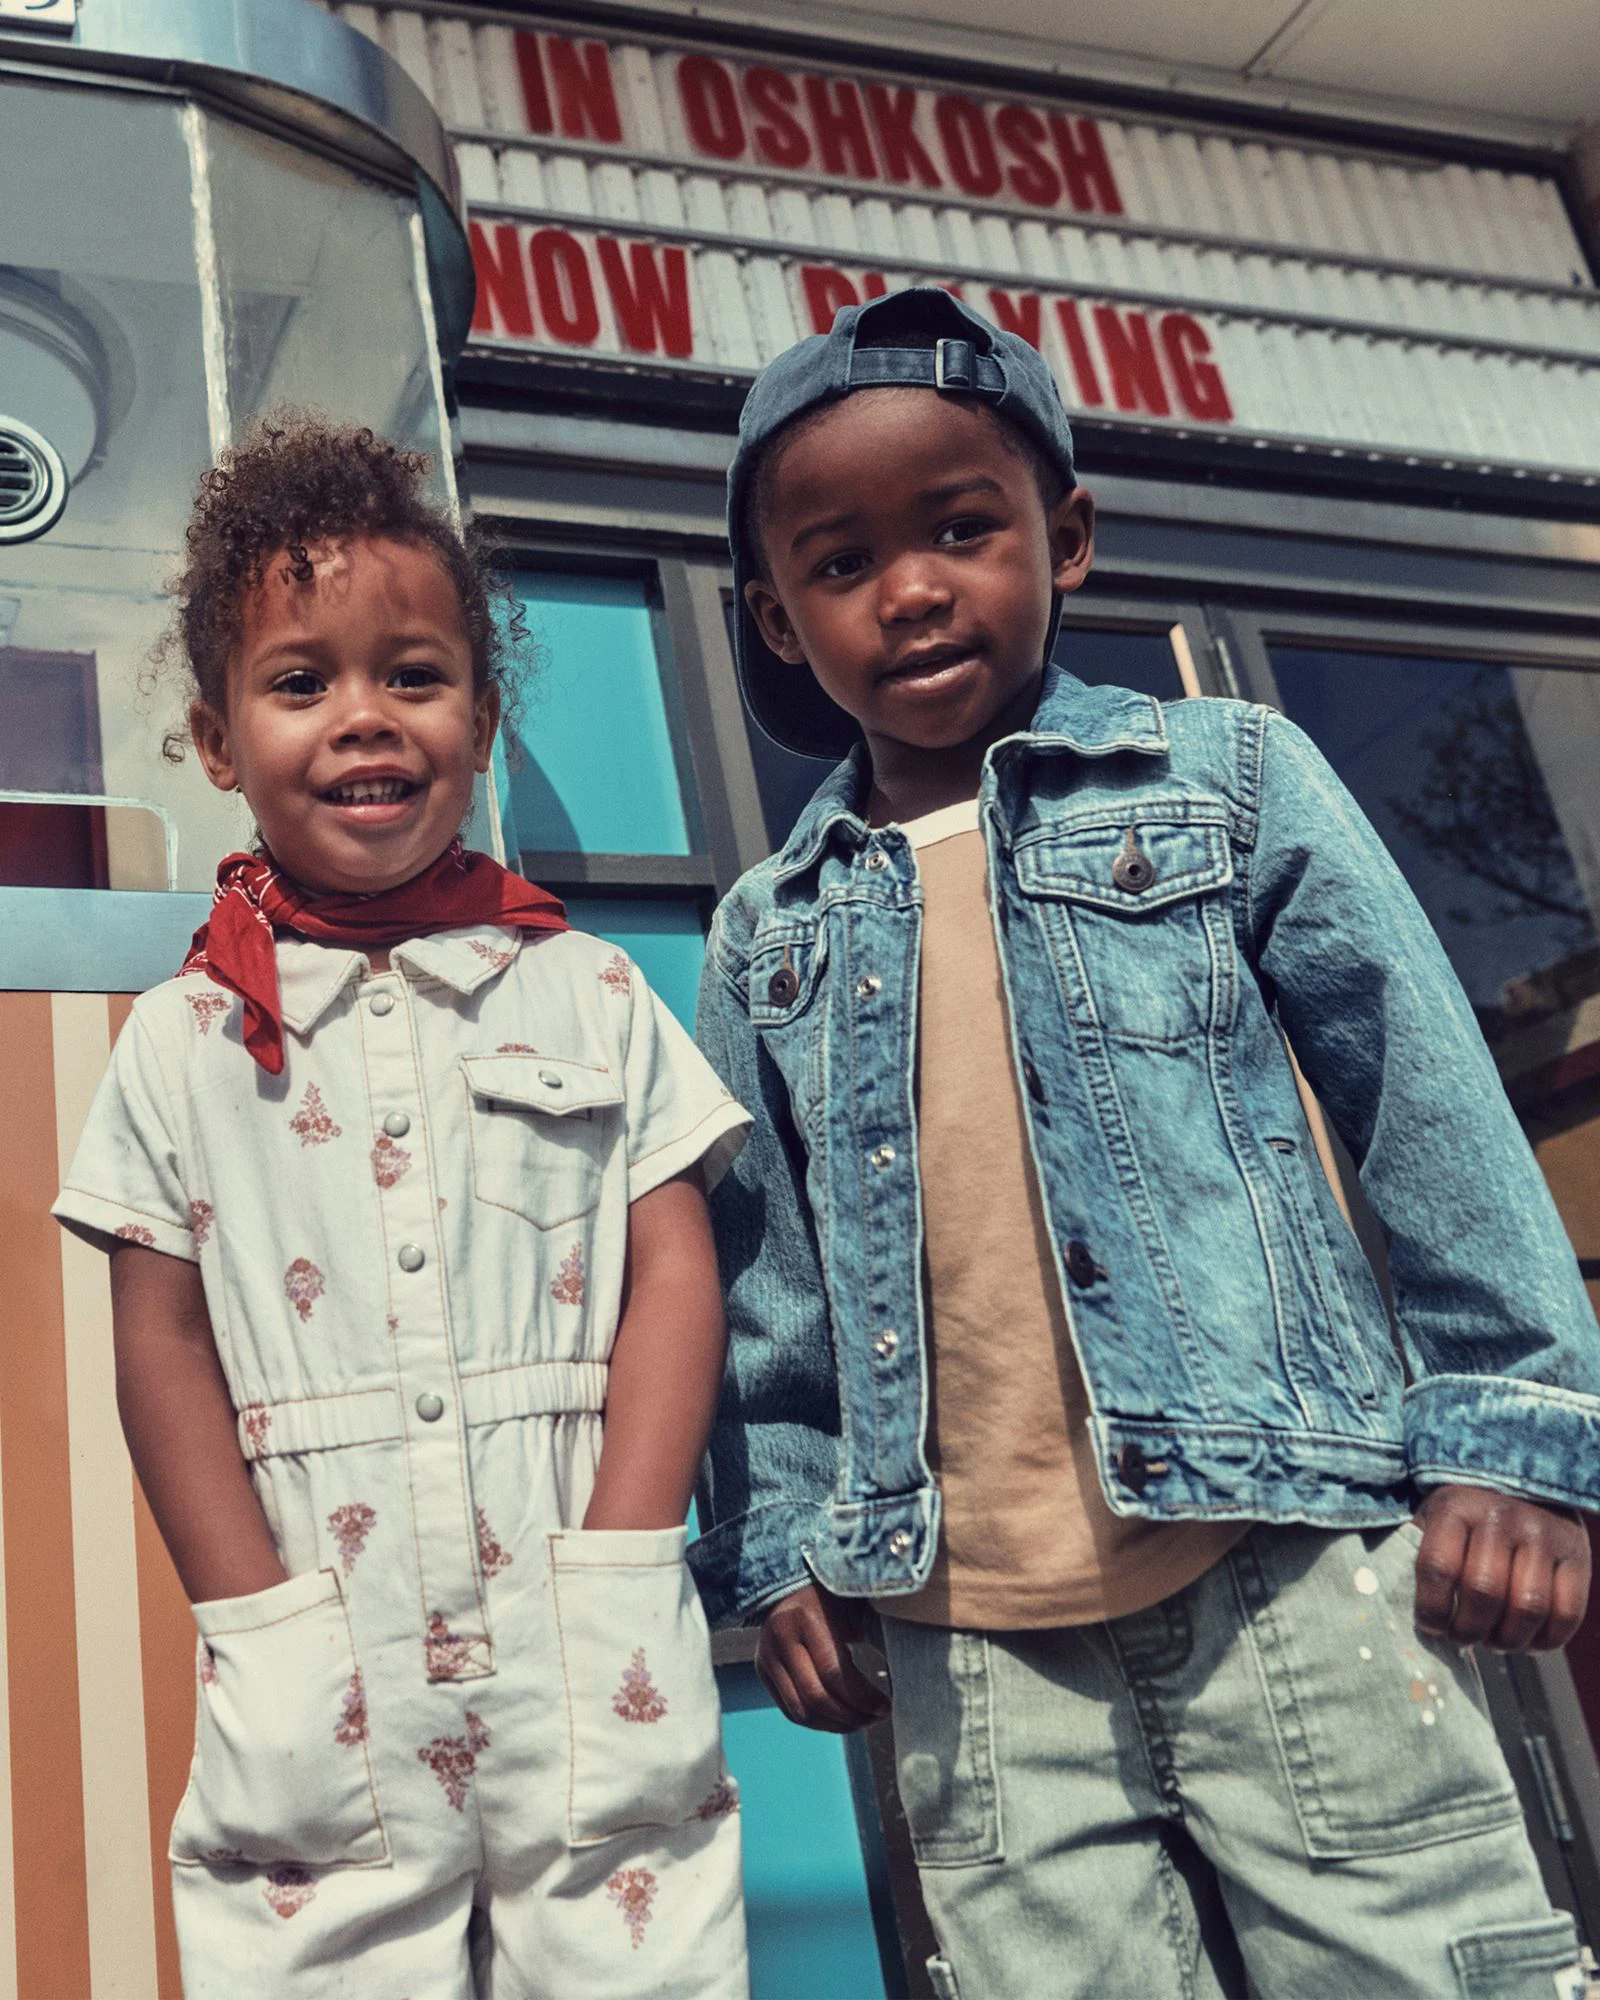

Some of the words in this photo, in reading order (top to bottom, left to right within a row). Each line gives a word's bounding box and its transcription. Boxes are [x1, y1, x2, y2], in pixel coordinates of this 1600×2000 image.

[514, 32, 624, 144] IN
[677, 54, 1124, 216] OSHKOSH
[468, 220, 694, 358] NOW
[801, 264, 1234, 423] PYING
